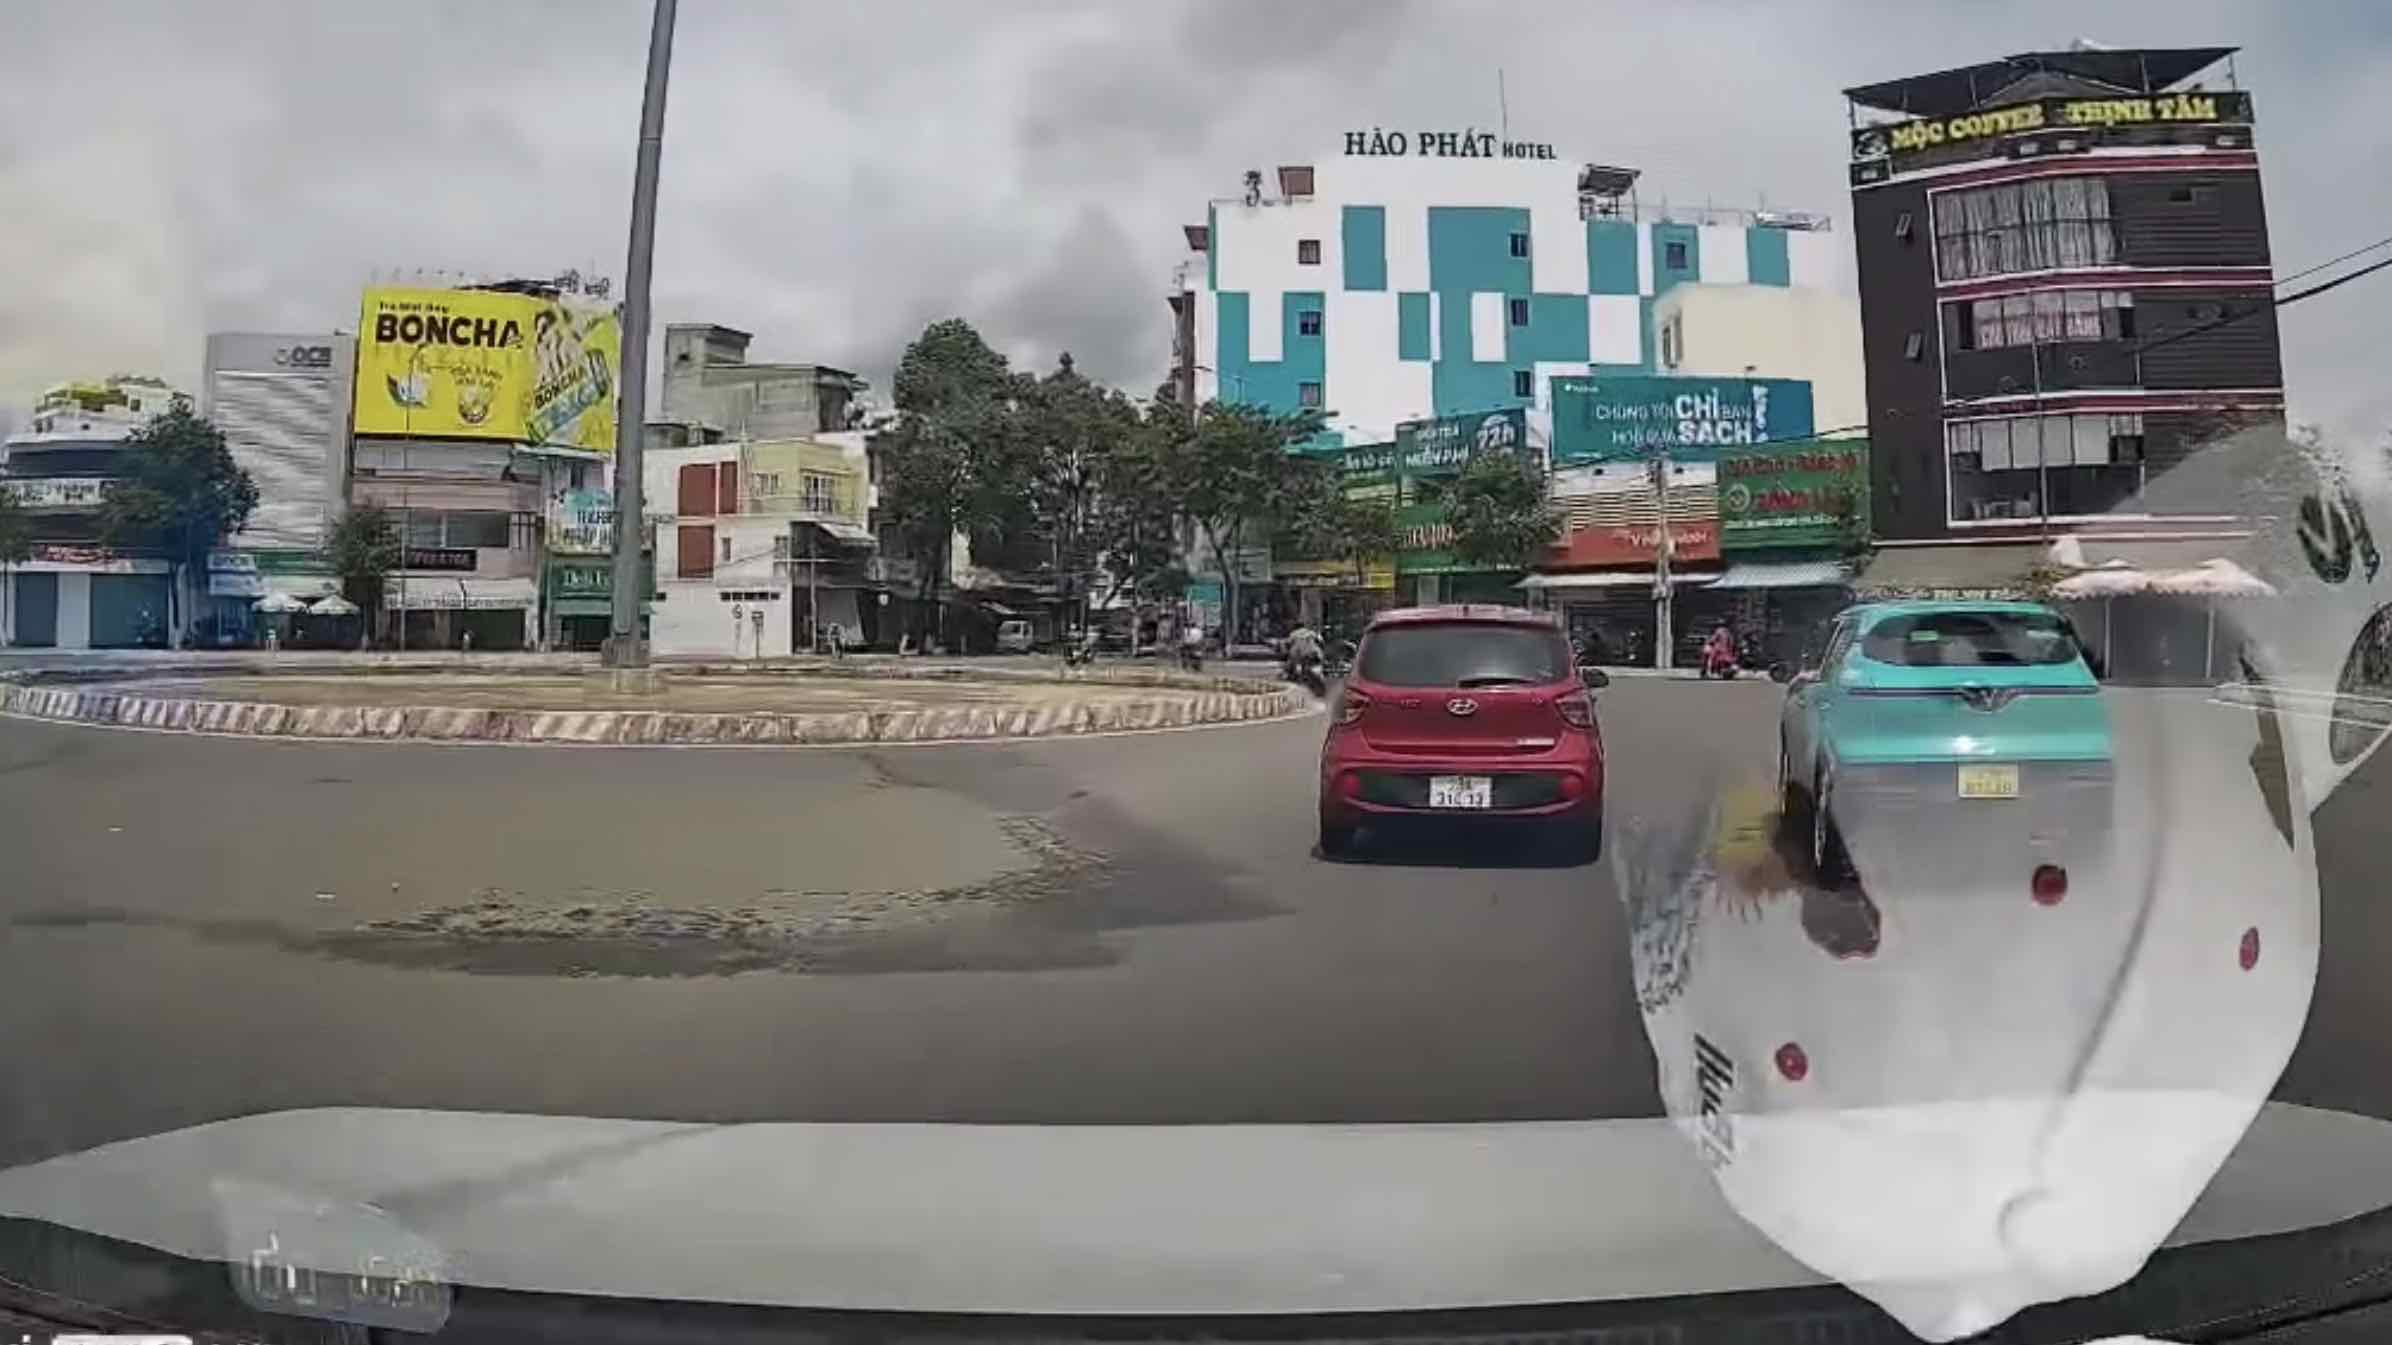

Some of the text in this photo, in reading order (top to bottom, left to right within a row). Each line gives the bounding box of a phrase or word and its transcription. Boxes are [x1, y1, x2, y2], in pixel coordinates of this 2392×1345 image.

[1891, 119, 1944, 150] MỘC
[2064, 99, 2152, 127] THỊNH
[2155, 93, 2217, 120] TÂM
[1344, 128, 1558, 160] HÀO PHÁT HOTEL
[376, 313, 524, 349] BONCHA
